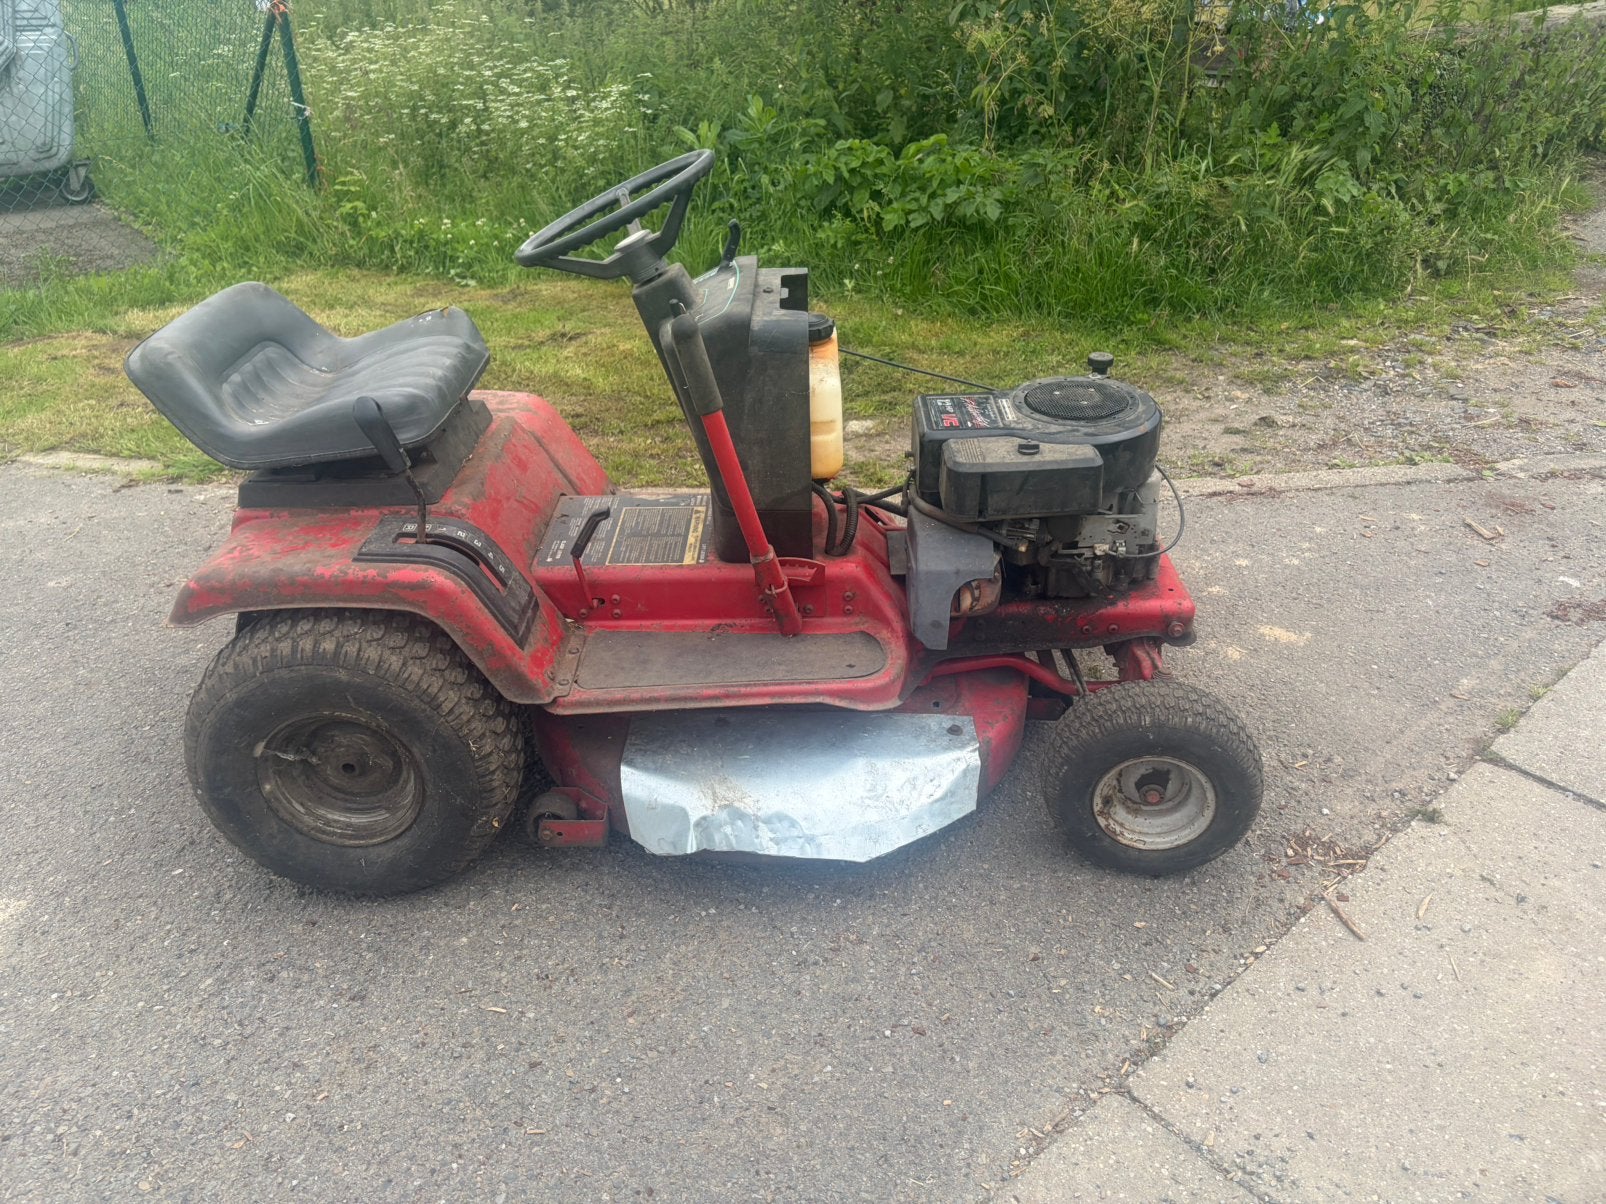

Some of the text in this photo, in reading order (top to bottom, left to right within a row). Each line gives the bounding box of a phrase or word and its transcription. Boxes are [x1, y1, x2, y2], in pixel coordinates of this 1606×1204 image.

[457, 530, 466, 538] 2
[473, 539, 482, 547] 3
[499, 565, 505, 573] 5
